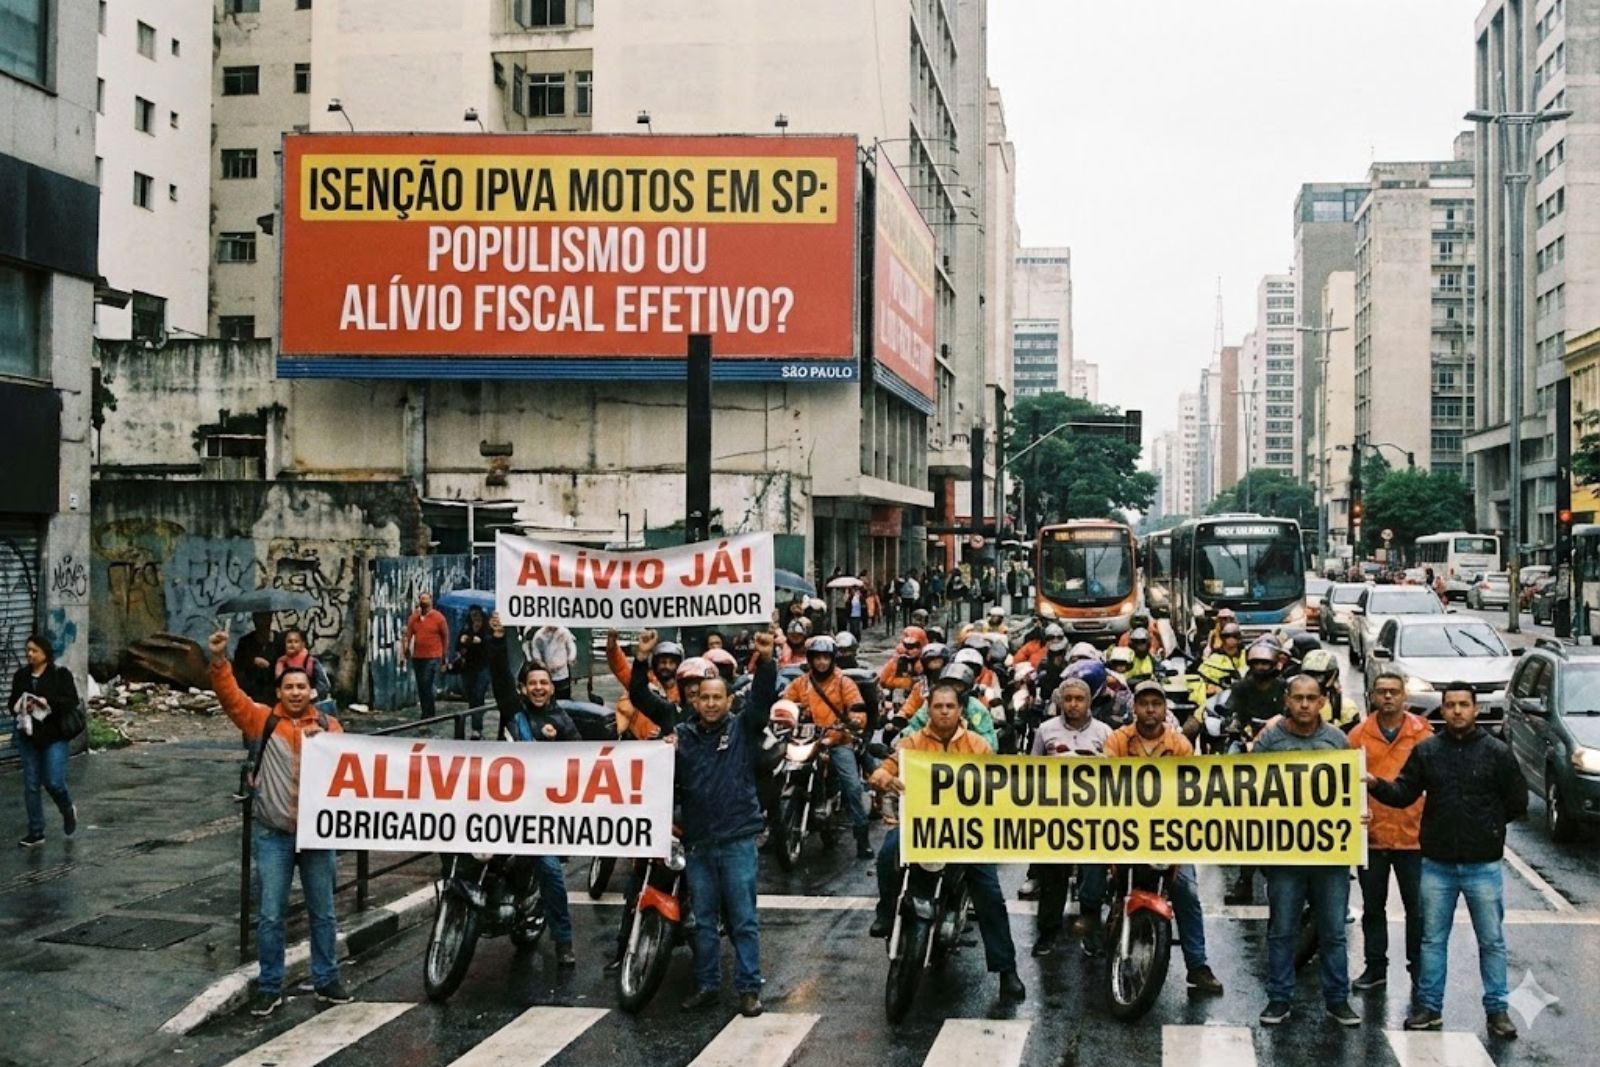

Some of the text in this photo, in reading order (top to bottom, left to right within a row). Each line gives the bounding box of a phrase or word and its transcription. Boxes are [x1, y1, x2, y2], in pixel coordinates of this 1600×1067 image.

[310, 159, 828, 220] ISENÇÃO IPVA MOTOS EM SP:
[429, 225, 706, 273] POPULISMO OU
[340, 274, 794, 334] ALÍVIO FISCAL EFETIVO?
[810, 366, 853, 378] PAULO
[517, 541, 752, 590] ALÍVIO JÁ!
[509, 593, 761, 619] OBRIGADO GOVERNADOR
[327, 743, 644, 805] ALÍVIO JÁ!
[931, 763, 1352, 808] POPULISMO BARATO!
[316, 809, 652, 847] OBRIGADO GOVERNADOR
[912, 817, 1352, 853] MAIS IMPOSTOS ESCONDIDOS?
